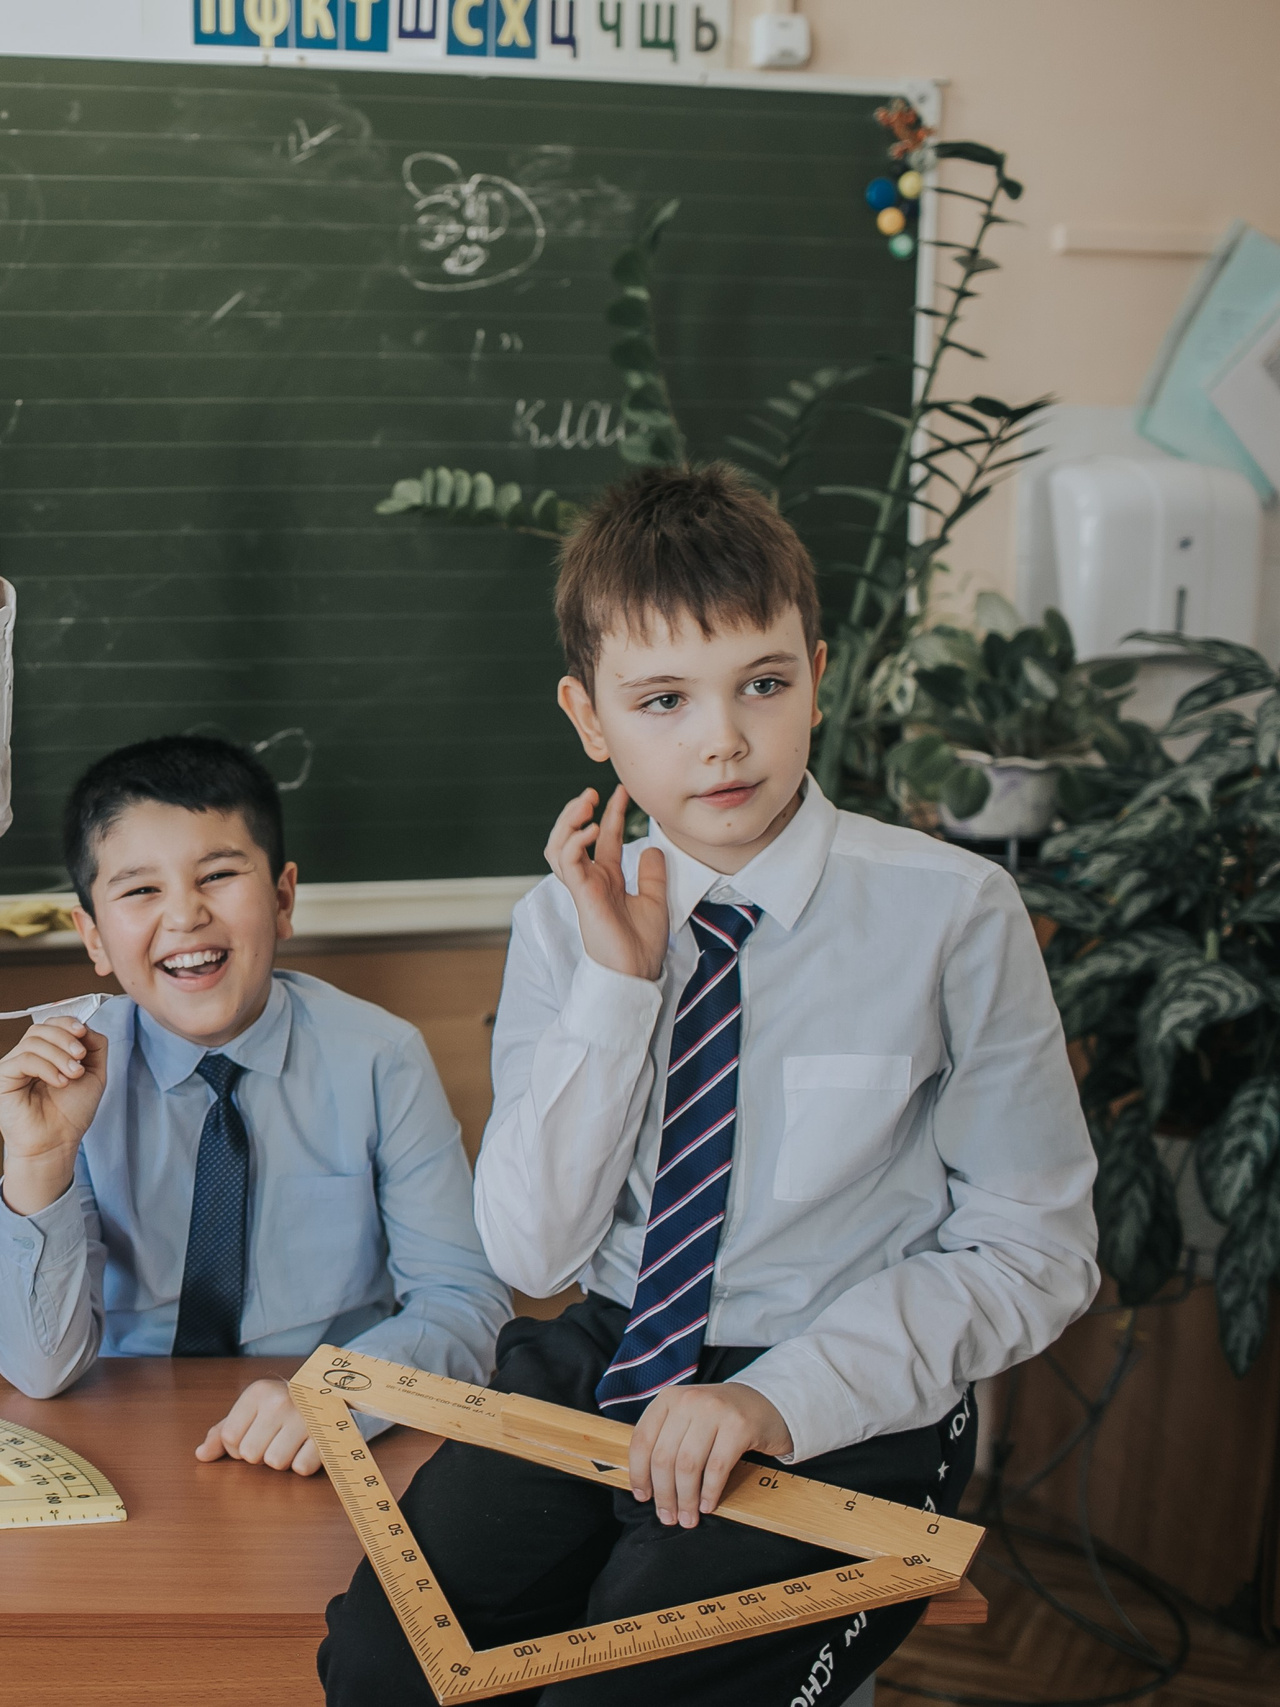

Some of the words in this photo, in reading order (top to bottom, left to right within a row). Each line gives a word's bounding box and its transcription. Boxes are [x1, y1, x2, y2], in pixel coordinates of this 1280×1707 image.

[331, 1357, 352, 1368] 40
[397, 1375, 418, 1388] 35
[464, 1394, 486, 1407] 30
[5, 1437, 25, 1446] 30
[36, 1453, 55, 1462] 20
[59, 1472, 77, 1481] 10
[10, 1457, 31, 1468] 160
[30, 1474, 49, 1486] 170
[45, 1492, 62, 1504] 180
[758, 1476, 780, 1490] 10
[843, 1500, 857, 1511] 5
[926, 1523, 940, 1535] 0
[336, 1420, 350, 1431] 10
[351, 1449, 366, 1461] 20
[363, 1475, 379, 1488] 30
[376, 1500, 391, 1512] 40
[388, 1523, 404, 1536] 50
[401, 1549, 417, 1563] 60
[416, 1578, 433, 1592] 70
[434, 1614, 451, 1628] 80
[450, 1662, 471, 1677] 90
[513, 1643, 542, 1658] 100
[567, 1631, 597, 1645] 110
[613, 1620, 642, 1635] 120
[657, 1610, 686, 1625] 130
[697, 1601, 726, 1615] 140
[738, 1591, 767, 1606] 150
[783, 1581, 812, 1595] 160
[835, 1568, 865, 1582] 170
[902, 1553, 931, 1567] 180
